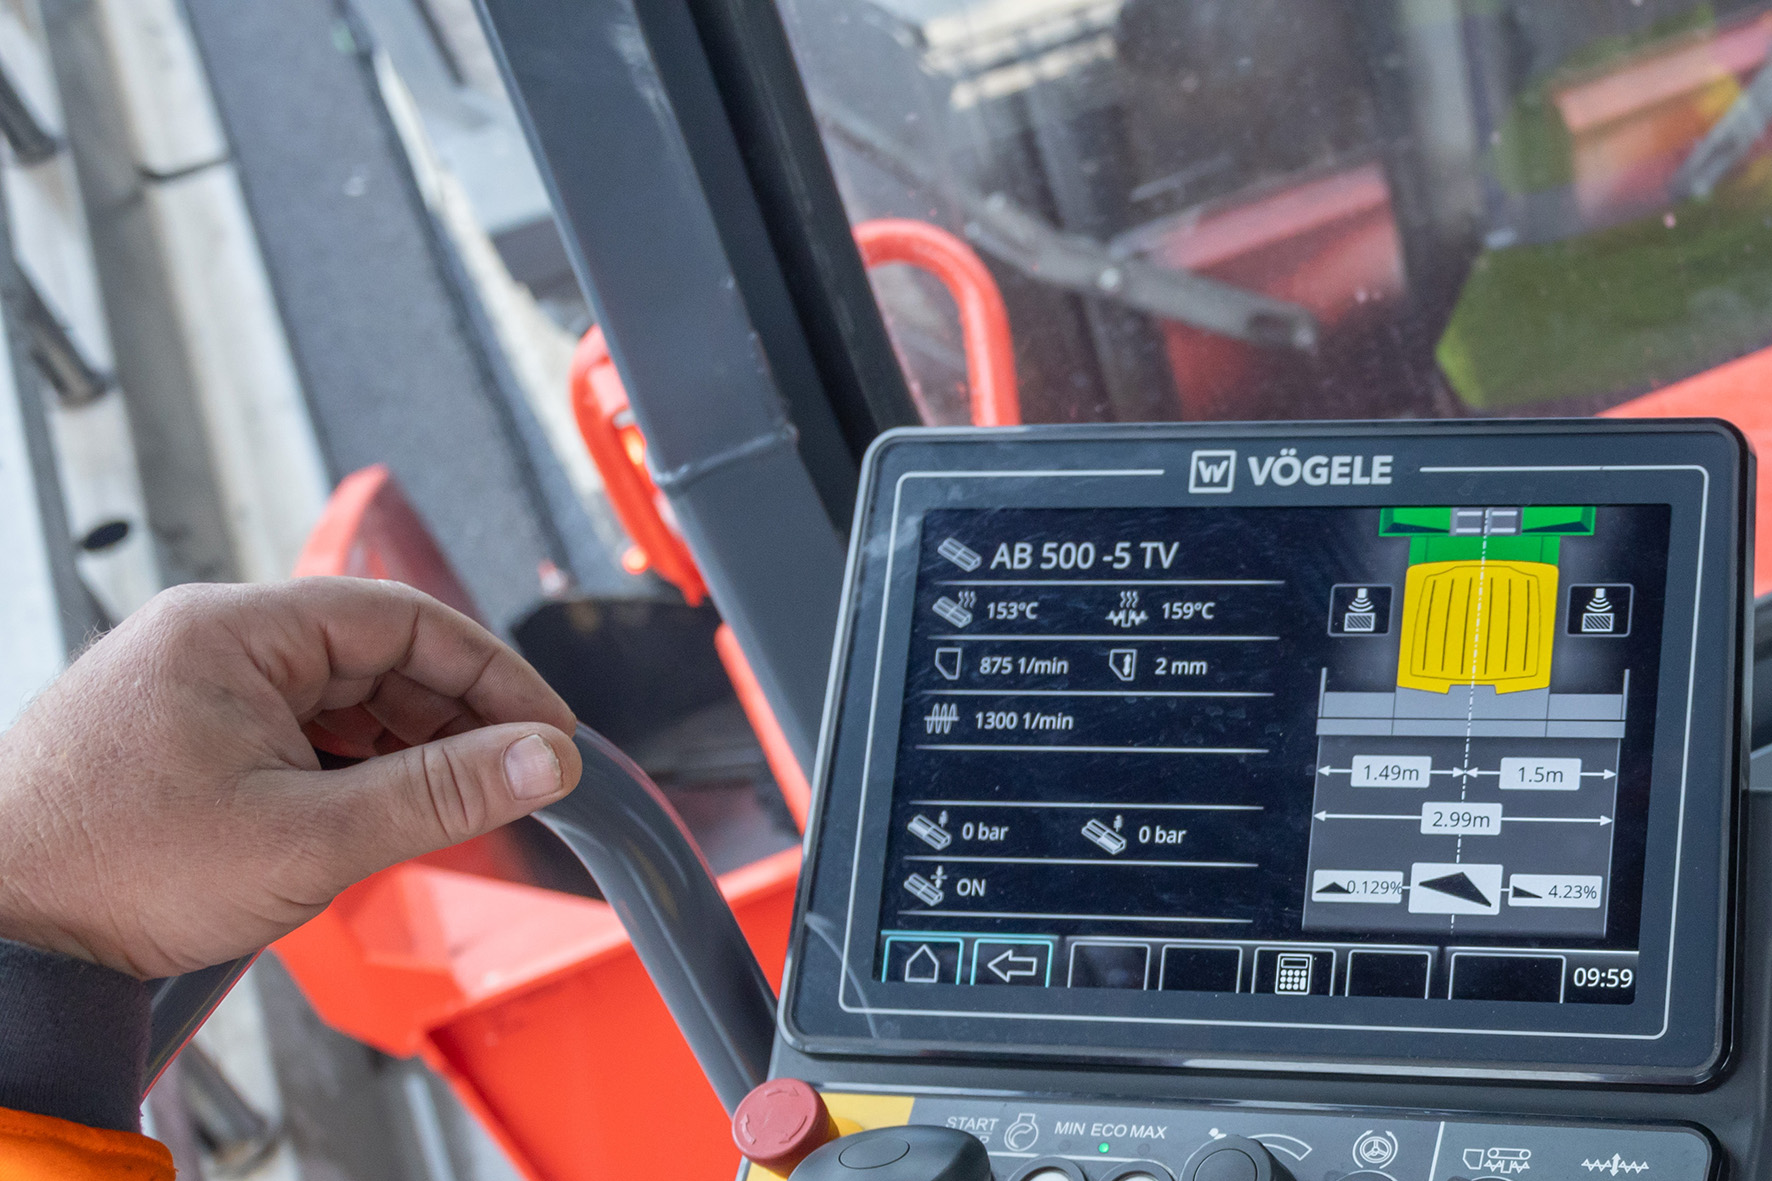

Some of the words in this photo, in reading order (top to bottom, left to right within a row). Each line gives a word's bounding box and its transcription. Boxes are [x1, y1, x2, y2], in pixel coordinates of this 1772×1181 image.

[1248, 448, 1394, 486] VÖGELE
[990, 542, 1033, 570] AB
[1040, 542, 1095, 570] 500
[1102, 542, 1132, 570] -5
[1139, 541, 1180, 569] TV
[979, 656, 1013, 674] 875
[1018, 656, 1069, 674] 1/min
[1154, 658, 1167, 675] 2
[1171, 661, 1207, 675] mm
[975, 712, 1018, 730] 1300
[1022, 712, 1074, 730] 1/min
[1363, 764, 1420, 781] 1.49m
[1518, 766, 1563, 783] 1.5m
[1432, 811, 1490, 828] 2.99m
[962, 823, 973, 841] 0
[977, 822, 1009, 841] bar
[1138, 826, 1150, 844] 0
[1154, 825, 1186, 844] bar
[956, 878, 986, 897] ON
[1548, 885, 1598, 900] 4.23%
[1573, 967, 1633, 988] 09:59
[945, 1116, 999, 1131] START
[1054, 1121, 1086, 1136] MIN
[1090, 1123, 1128, 1138] ECO
[1130, 1124, 1168, 1140] MAX
